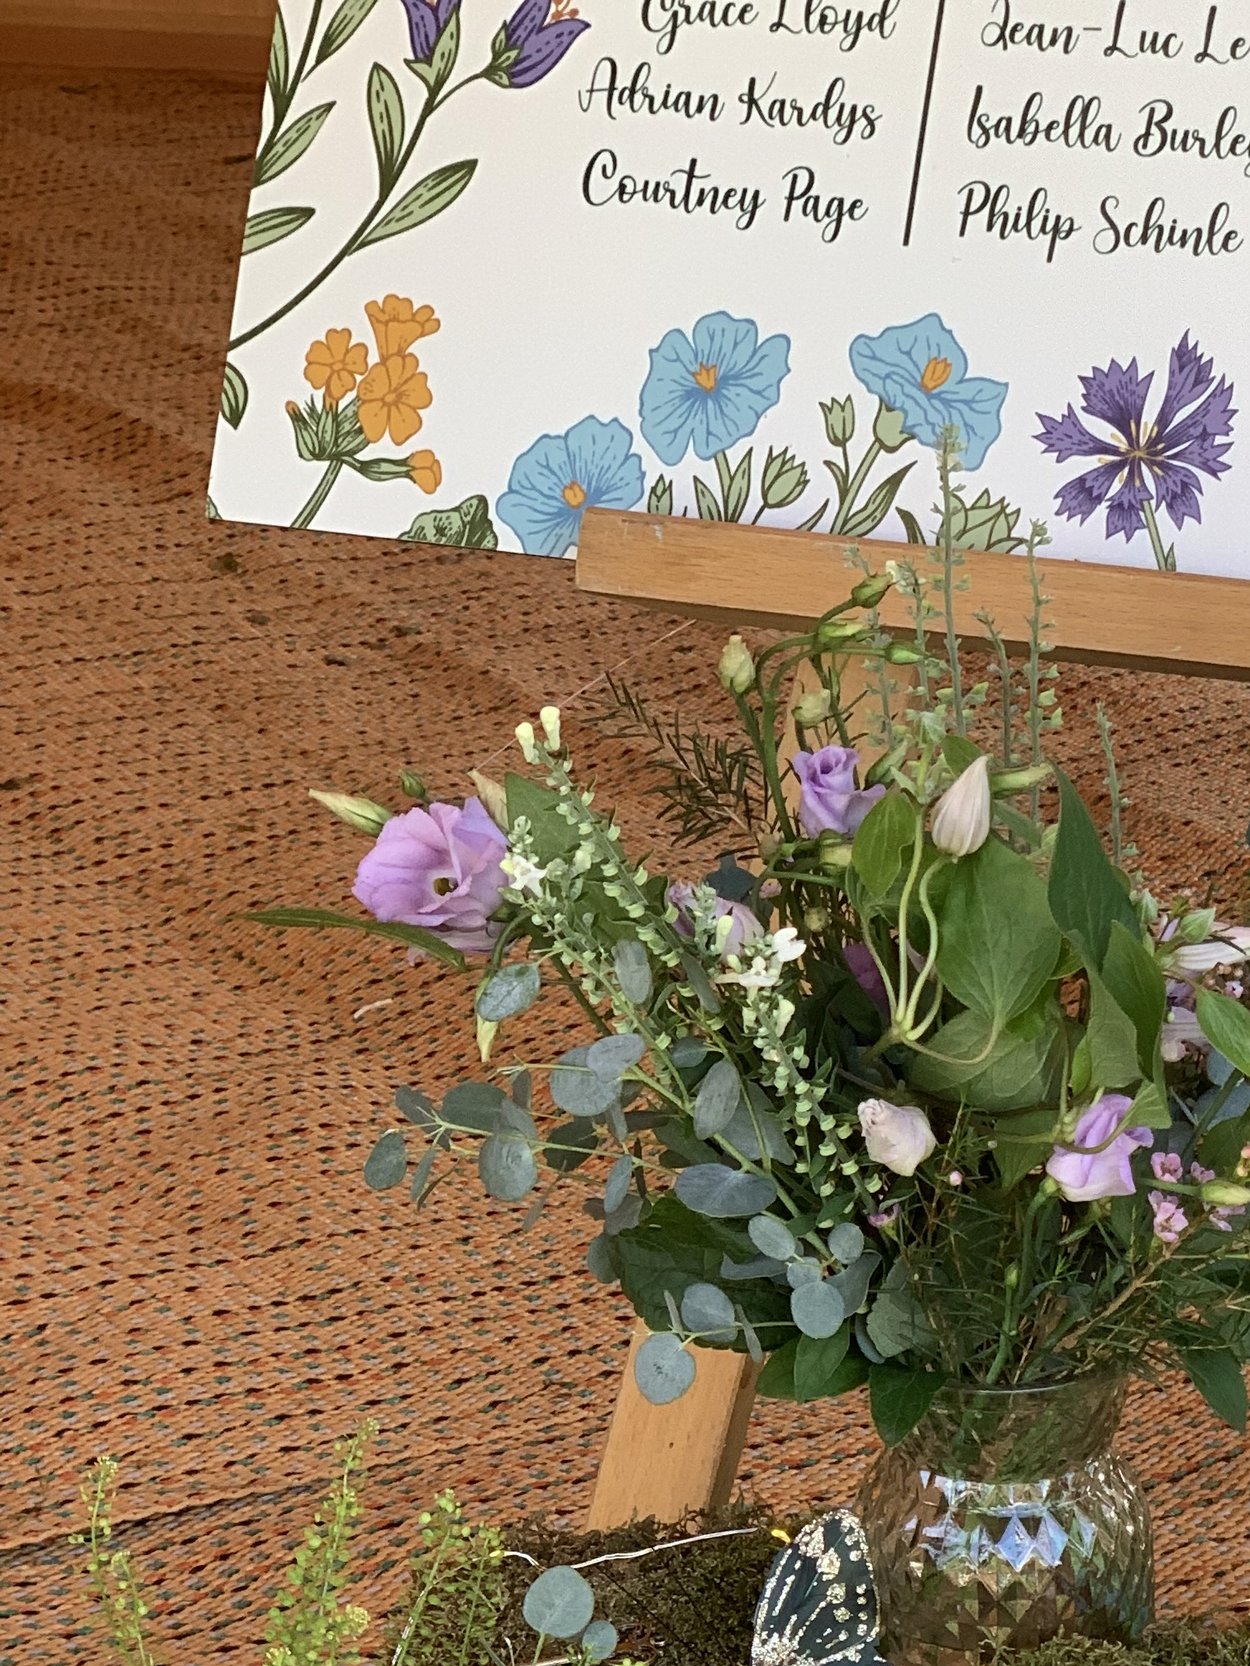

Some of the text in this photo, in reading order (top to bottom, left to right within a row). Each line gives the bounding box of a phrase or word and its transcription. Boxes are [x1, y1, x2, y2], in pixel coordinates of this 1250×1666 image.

[641, 0, 901, 56] Grace Lloyd
[981, 0, 1184, 59] Jean-Luc
[577, 56, 883, 146] Adrian Kardys
[967, 84, 1122, 153] Isabella
[582, 148, 869, 244] Courtney Page
[957, 180, 1244, 264] Philip Schinle
